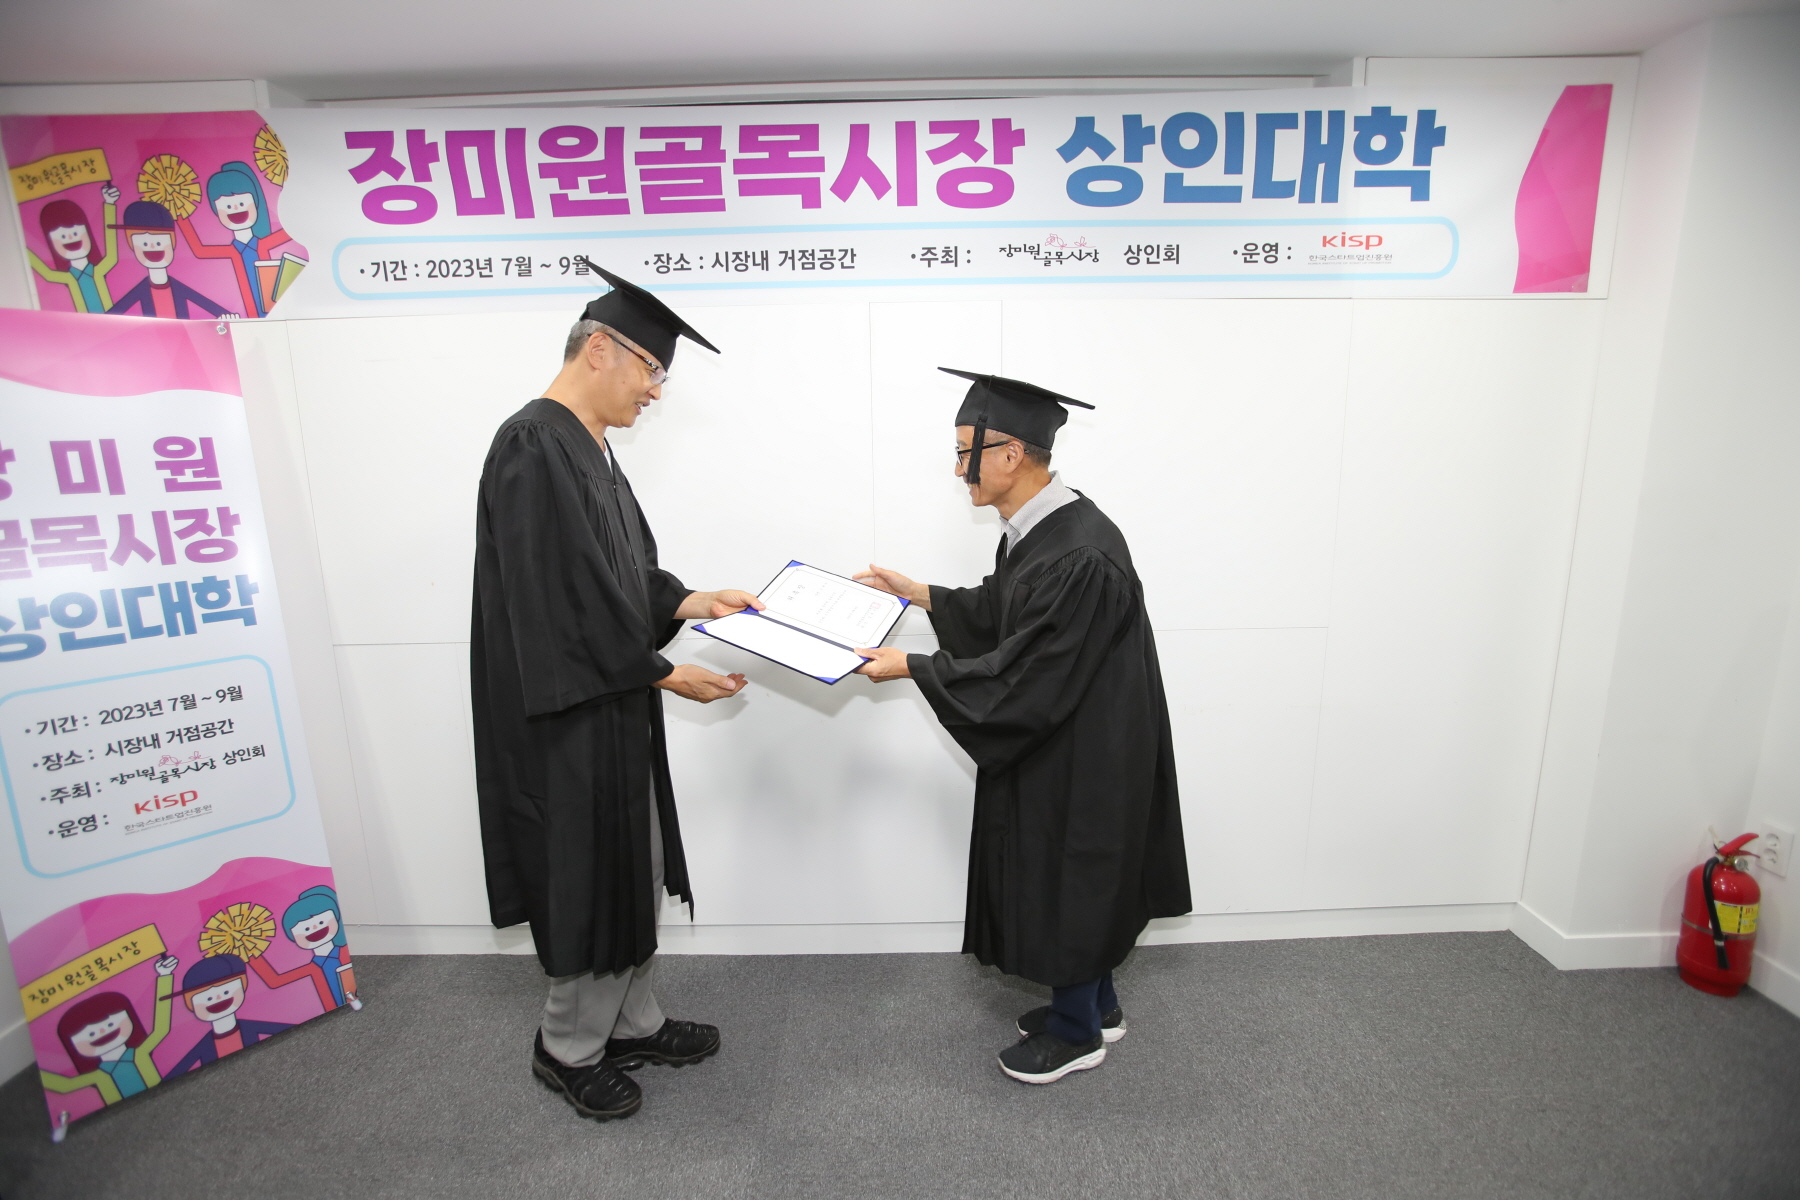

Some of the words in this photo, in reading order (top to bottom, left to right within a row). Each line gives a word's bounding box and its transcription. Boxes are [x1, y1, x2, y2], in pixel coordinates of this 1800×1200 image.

[18, 158, 95, 190] 장미원골목시장
[344, 118, 1026, 225] 장미원골목시장
[1056, 106, 1447, 208] 상인대학
[425, 257, 494, 279] 2023년
[501, 256, 533, 277] 7월
[558, 255, 590, 276] 9월
[711, 250, 770, 272] 시장내
[778, 248, 857, 271] 거점공간
[999, 243, 1100, 267] 장미원골목시장
[1123, 244, 1180, 265] 상인회
[98, 699, 164, 726] 2023년
[167, 693, 198, 712] 7월
[215, 685, 244, 703] 9월
[104, 733, 161, 758] 시장내
[166, 719, 235, 745] 거점공간
[110, 757, 217, 784] 장미원골목시장
[222, 744, 267, 767] 상인회
